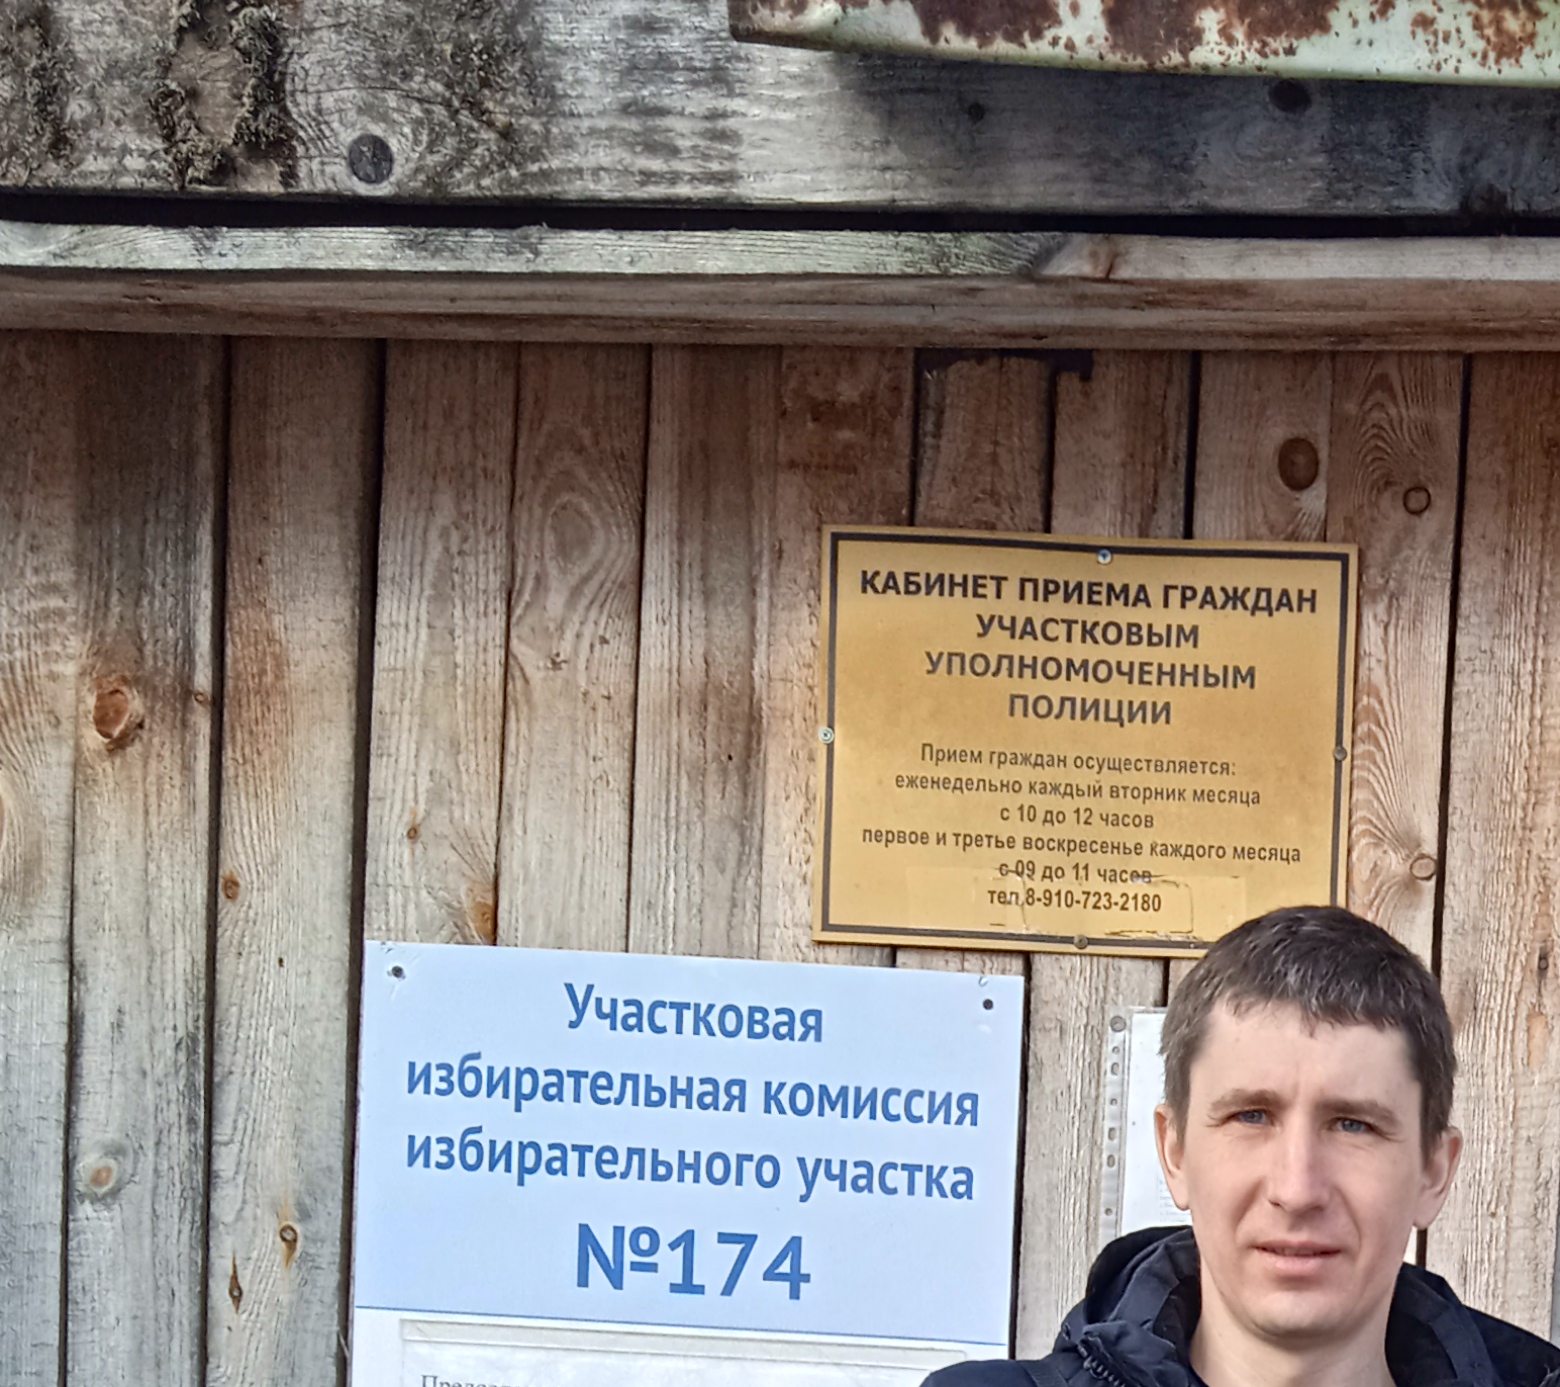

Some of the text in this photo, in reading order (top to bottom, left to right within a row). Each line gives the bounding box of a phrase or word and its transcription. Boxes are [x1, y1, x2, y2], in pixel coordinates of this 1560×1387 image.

[860, 570, 1317, 616] КАБИНЕТ ПРИЕМА ГРАЖДАН
[976, 614, 1199, 649] УЧАСТКОВЫМ
[925, 651, 1256, 689] УПОЛНОМОЧЕННЫМ
[1009, 694, 1171, 728] ПОЛИЦИИ
[921, 743, 1236, 778] Прием граждан осуществляется:
[895, 773, 1260, 807] еженедельно каждый вторник месяца
[1000, 806, 1154, 829] с 10 до 12 часов
[862, 828, 1301, 864] первое и третье воскресенье каждого месяца
[1015, 861, 1035, 881] 09
[1041, 866, 1067, 883] до
[1073, 863, 1091, 882] 11
[1096, 868, 1152, 884] часов
[564, 982, 823, 1042] Участковая
[406, 1052, 979, 1127] избирательная комиссия
[406, 1126, 974, 1202] избирательного участка
[576, 1223, 810, 1300] №174
